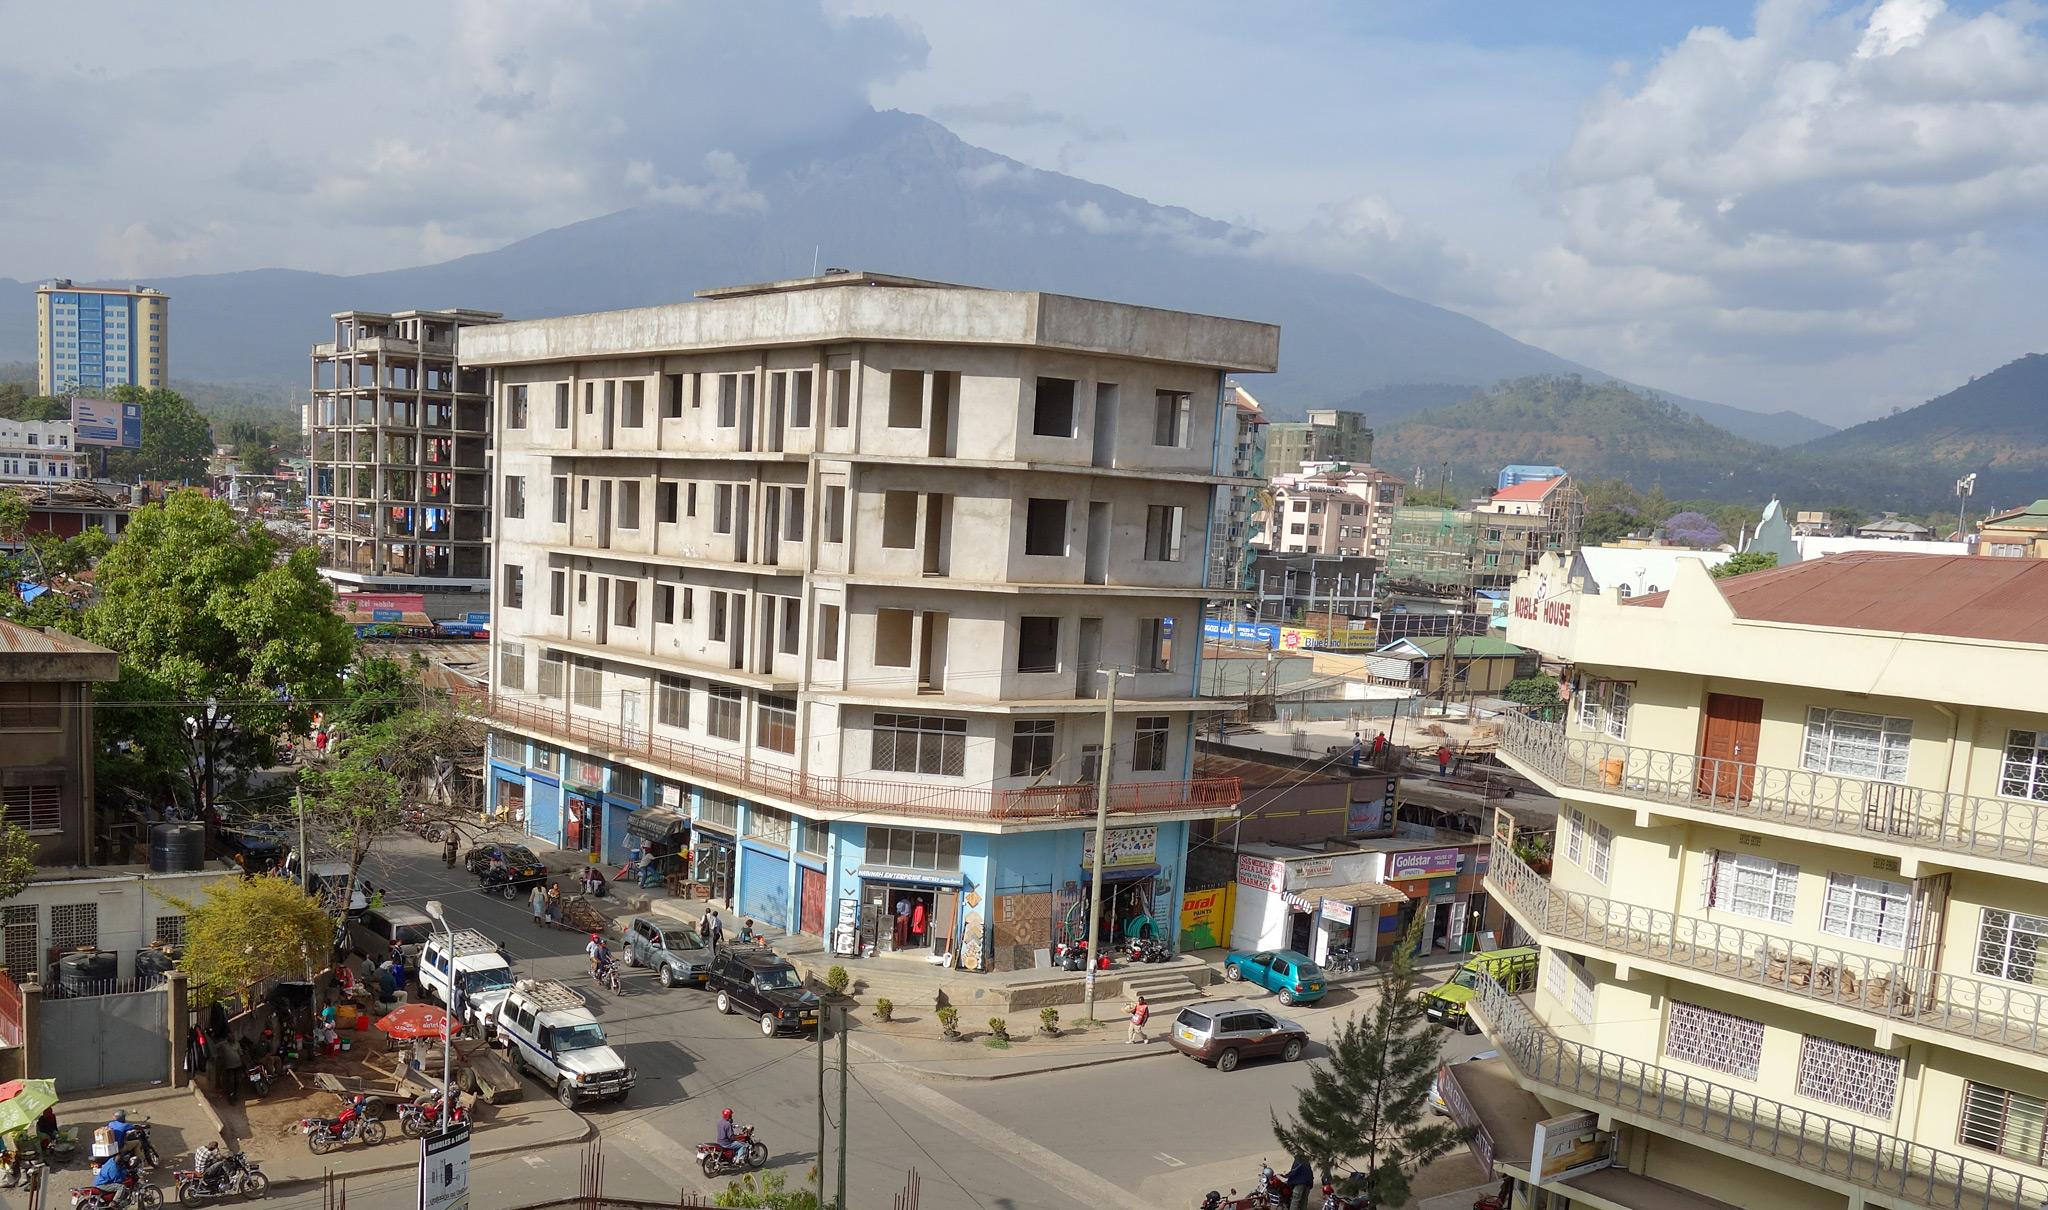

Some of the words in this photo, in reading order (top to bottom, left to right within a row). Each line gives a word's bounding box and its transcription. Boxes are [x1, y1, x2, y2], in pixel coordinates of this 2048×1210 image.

[1515, 596, 1539, 621] NOBLE
[1543, 600, 1571, 627] HOUSE
[1324, 636, 1342, 647] Bnd
[1396, 855, 1431, 868] Goldstar
[1240, 876, 1269, 890] PHARMACY
[1183, 893, 1217, 911] oral
[455, 1130, 469, 1142] LOCKS
